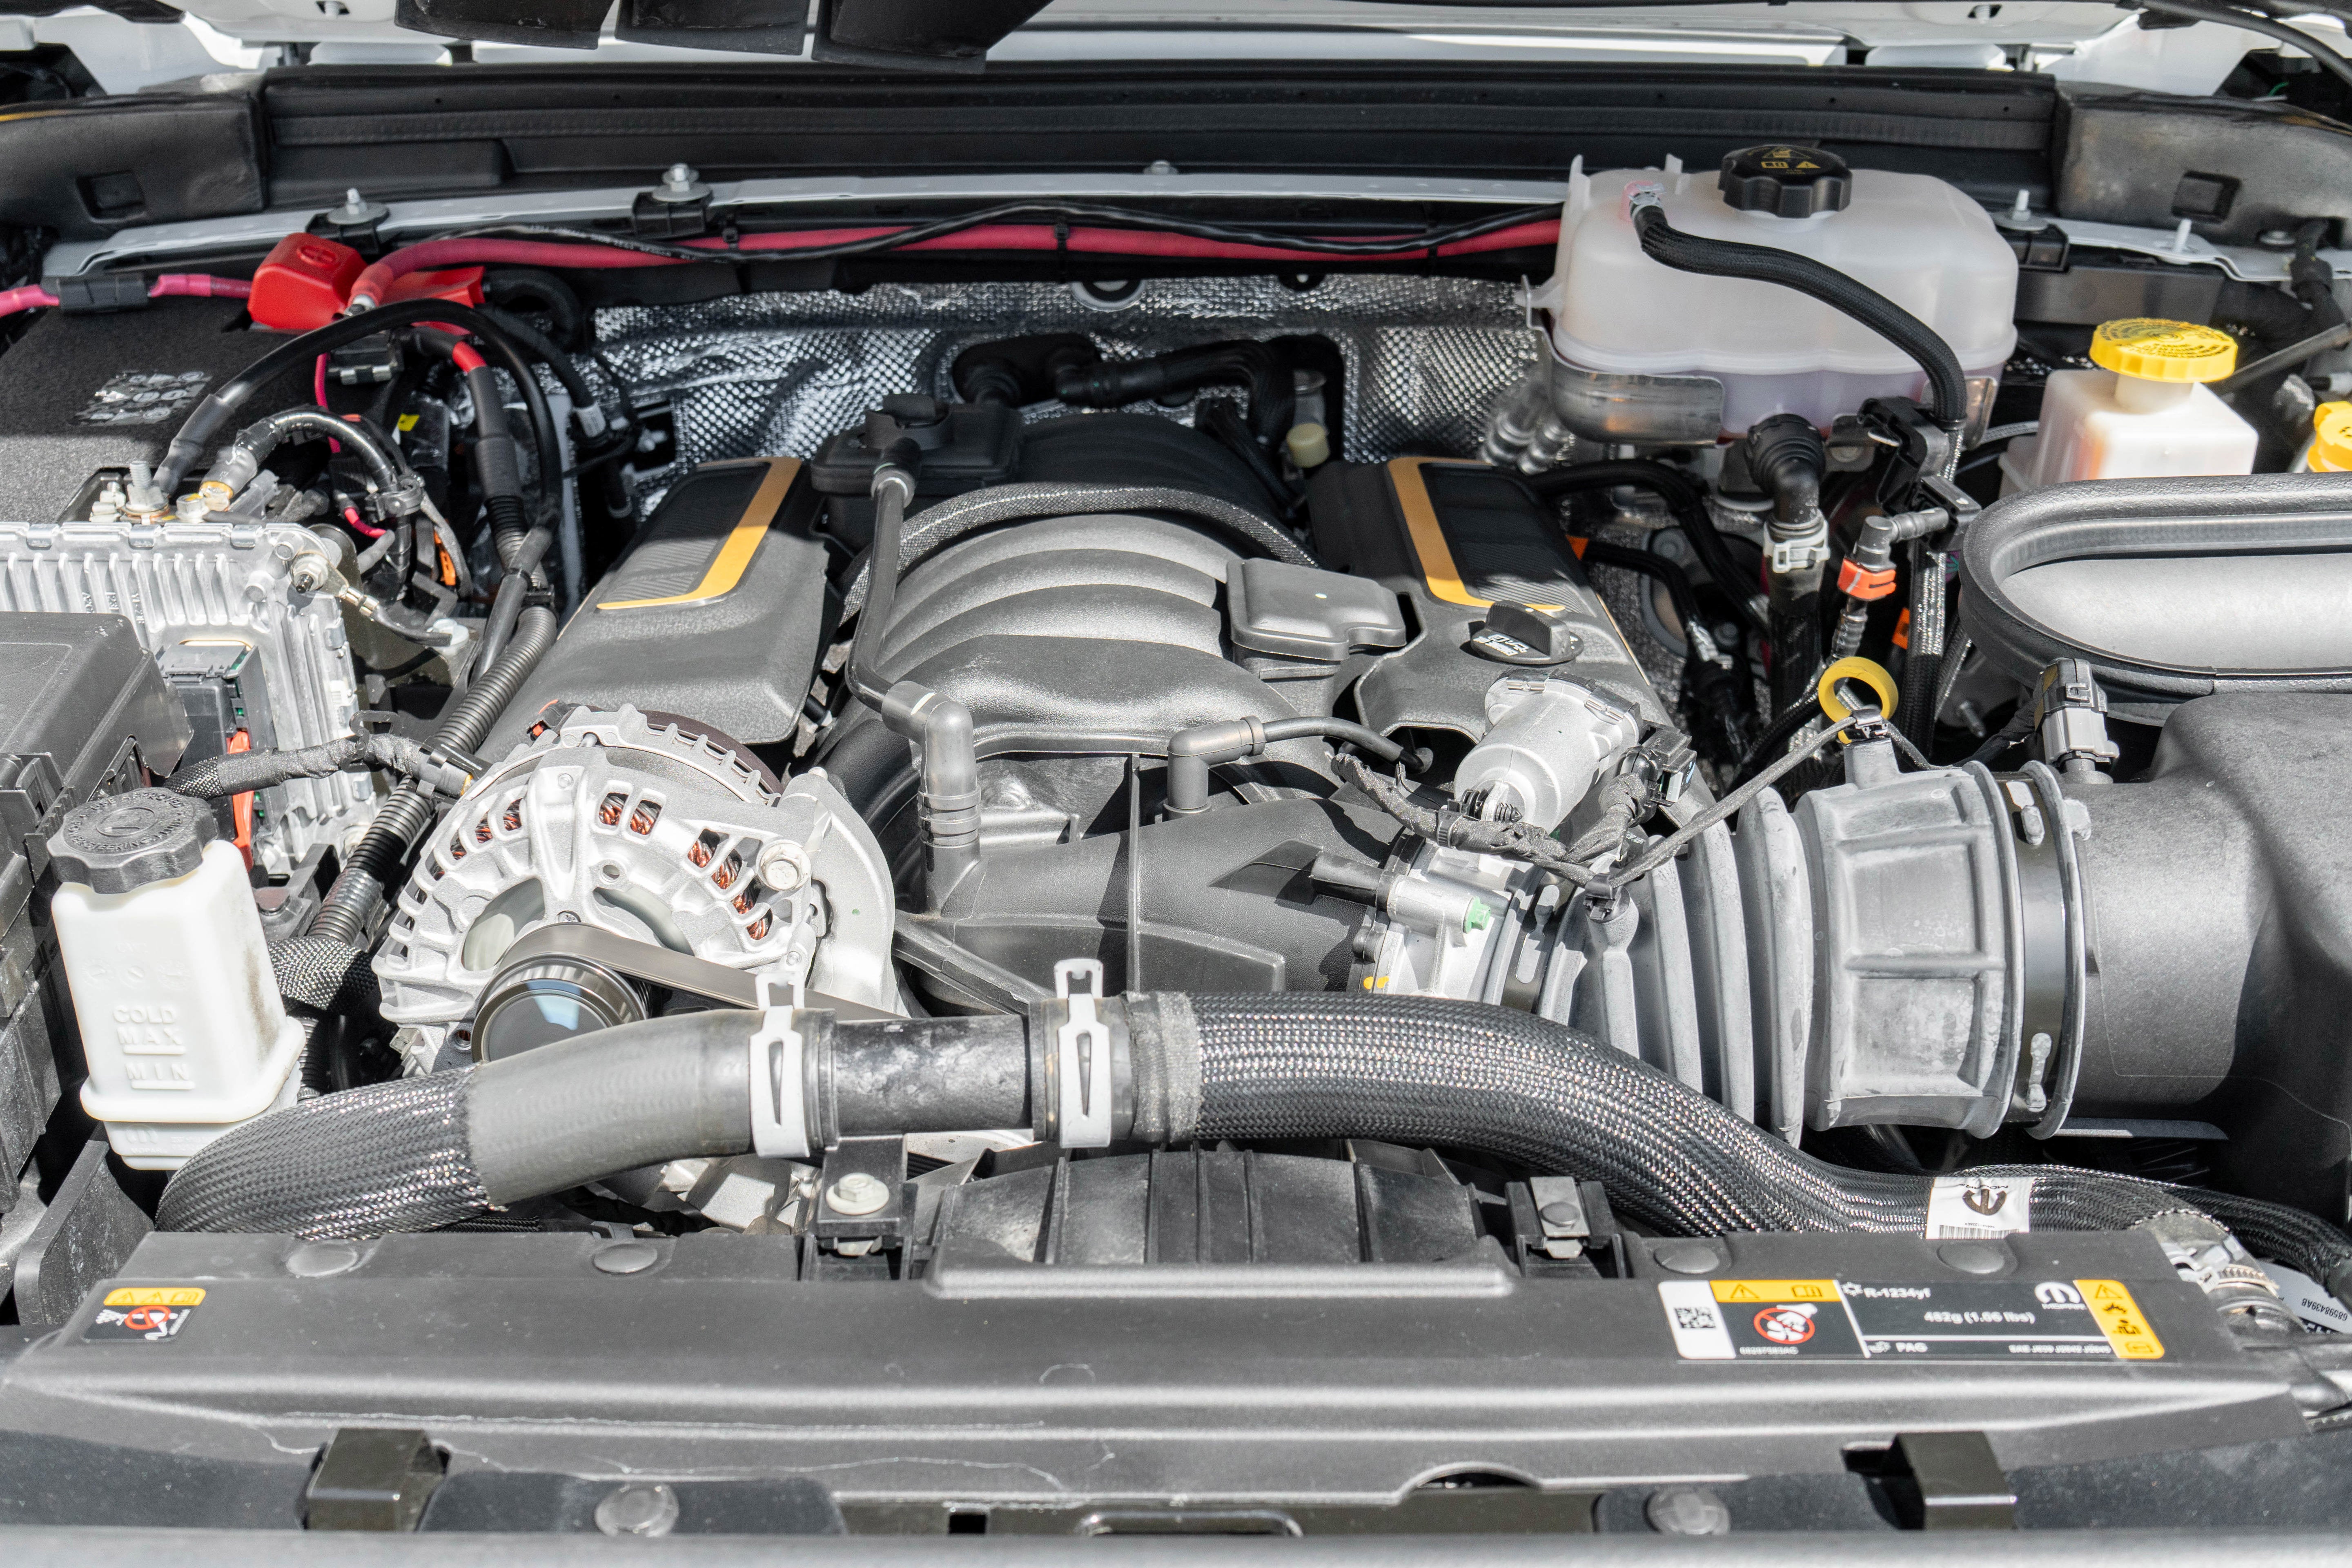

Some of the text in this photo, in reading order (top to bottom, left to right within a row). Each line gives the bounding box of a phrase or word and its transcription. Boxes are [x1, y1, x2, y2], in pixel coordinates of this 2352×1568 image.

[1485, 641, 1519, 656] ENGINE
[91, 798, 118, 811] USE
[68, 818, 183, 851] POWER STEERING FLUID
[114, 1004, 177, 1024] COLD
[118, 1025, 183, 1045] MAX
[126, 1061, 190, 1081] MIN
[1863, 1287, 1931, 1299] R-1234yf
[2301, 1298, 2348, 1321] 68598439AB
[1964, 1311, 2002, 1324] (1.06
[2003, 1311, 2036, 1324] lbs)
[1895, 1342, 1928, 1353] PAG
[2008, 1344, 2031, 1353] SAE
